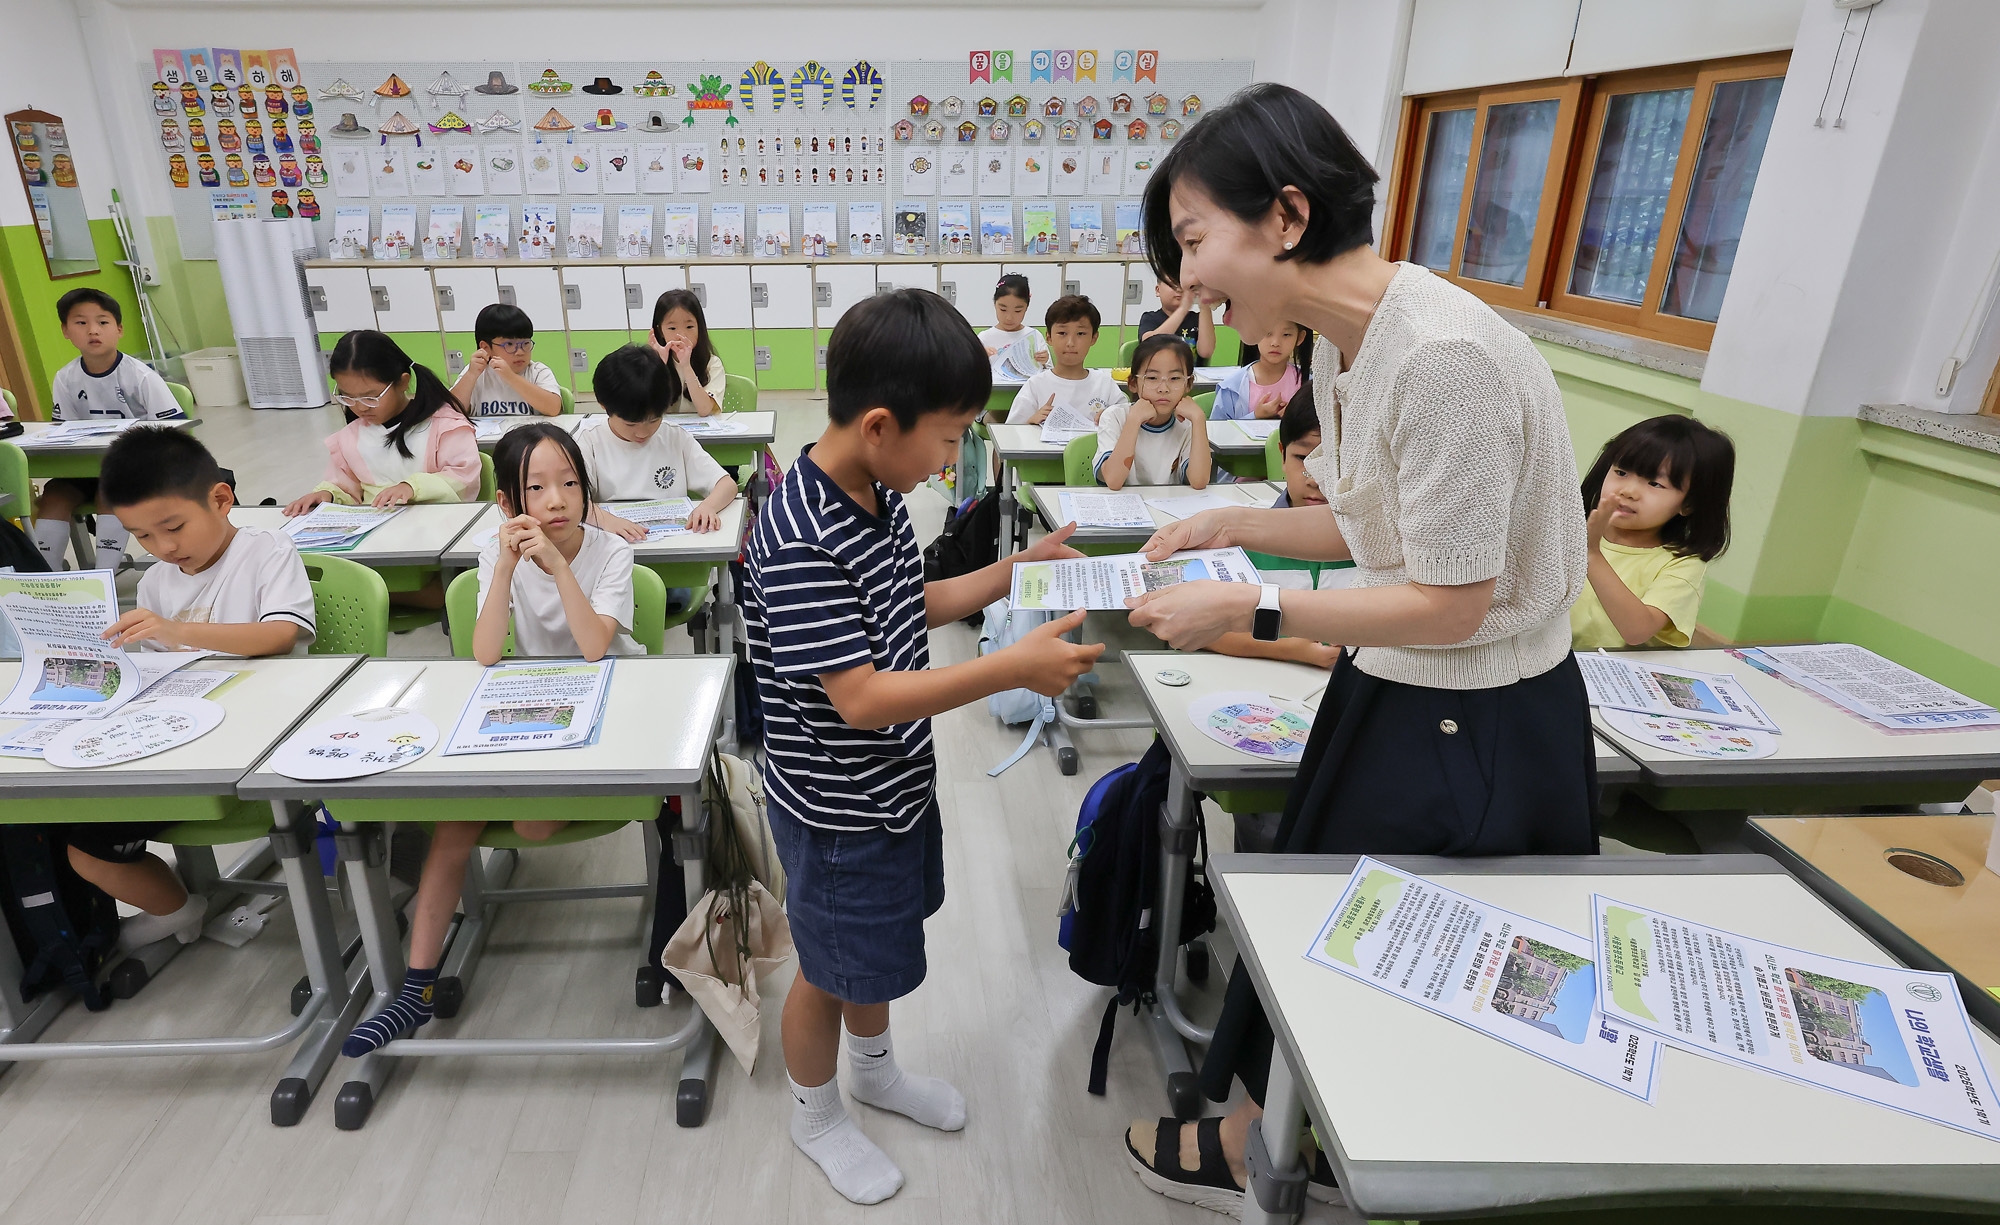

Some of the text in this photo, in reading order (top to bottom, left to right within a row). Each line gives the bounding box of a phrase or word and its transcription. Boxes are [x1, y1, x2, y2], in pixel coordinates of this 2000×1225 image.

[974, 54, 1152, 70] 꿈을 키우는 교실
[325, 748, 348, 758] 여름
[360, 751, 402, 762] 즐거운
[1497, 921, 1512, 939] 신나는
[1476, 930, 1493, 953] 슬기롭고
[1493, 937, 1506, 950] 학교
[1470, 951, 1485, 970] 바르며
[1487, 948, 1502, 966] 즐거운
[1611, 934, 1624, 975] 서울중평초등학교
[1764, 953, 1779, 972] 신나는
[1482, 964, 1496, 979] 배움
[1752, 965, 1769, 991] 슬기롭고
[1768, 971, 1783, 985] 학교
[1758, 989, 1775, 1011] 바르며
[1772, 984, 1788, 1005] 즐거운
[1777, 1004, 1792, 1020] 배움
[1902, 1007, 1952, 1084] 나의 학교생활
[1621, 1033, 1639, 1082] 026학년도 1학기
[1953, 1063, 1992, 1126] 2026학년도 1학기
